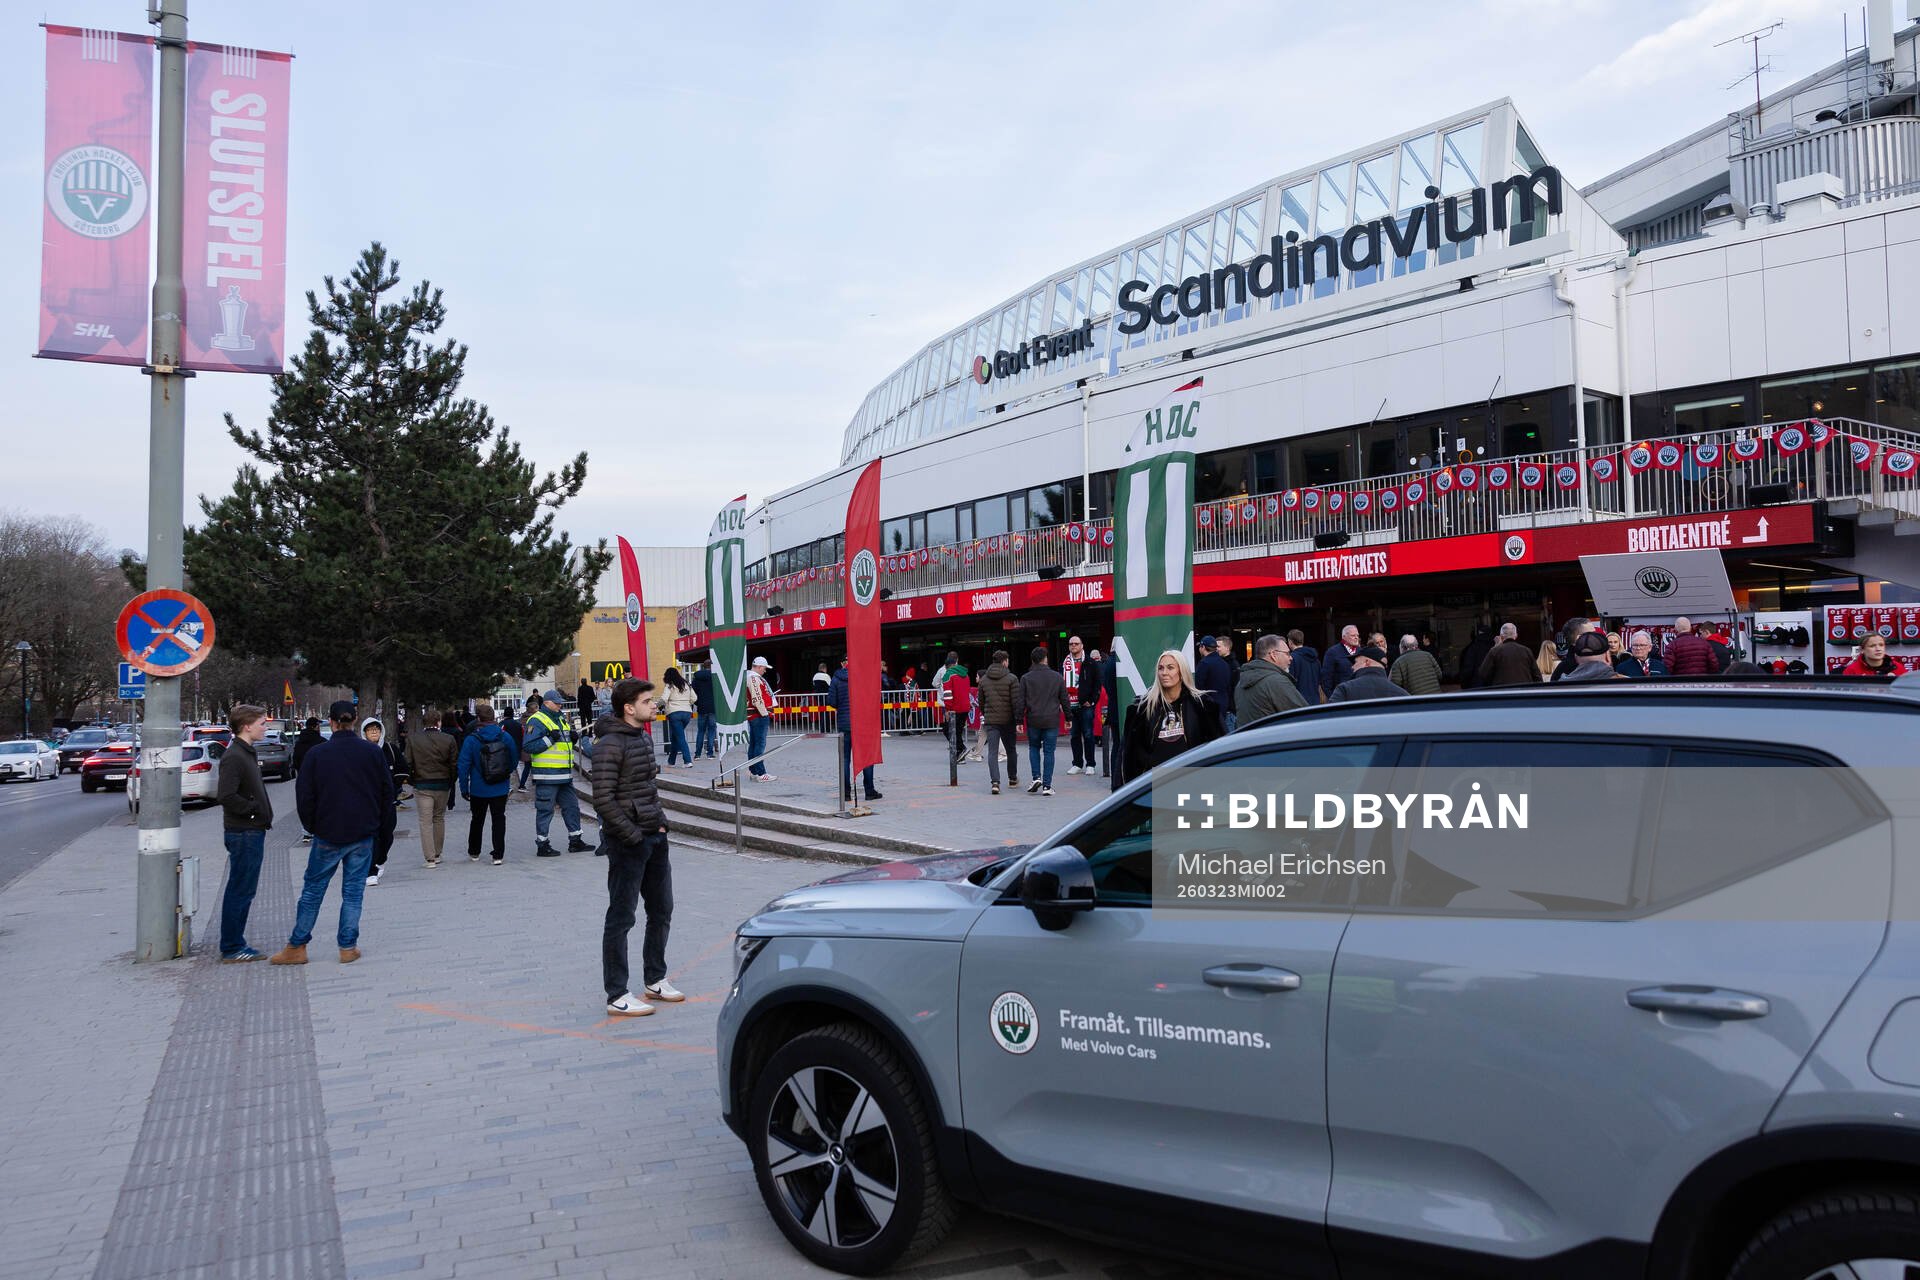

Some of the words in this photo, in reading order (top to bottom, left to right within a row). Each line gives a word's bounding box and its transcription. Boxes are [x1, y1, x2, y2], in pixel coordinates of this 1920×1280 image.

[207, 89, 268, 288] SLUTSPEL
[1117, 164, 1564, 335] Scandinavium
[72, 322, 116, 339] SHL
[993, 341, 1031, 379] Got
[1032, 318, 1095, 367] Event
[1627, 514, 1732, 553] BORTAENTRÉ
[1284, 551, 1388, 582] BILJETTER/TICKETS
[1068, 581, 1104, 603] VIP/LOGE
[896, 600, 912, 620] ENTRÉ
[128, 666, 142, 684] P
[1059, 1009, 1131, 1035] Framåt.
[1134, 1016, 1272, 1049] Tillsammans.
[1061, 1037, 1089, 1052] Med
[1090, 1039, 1125, 1056] Volvo
[1127, 1044, 1158, 1060] Cars
